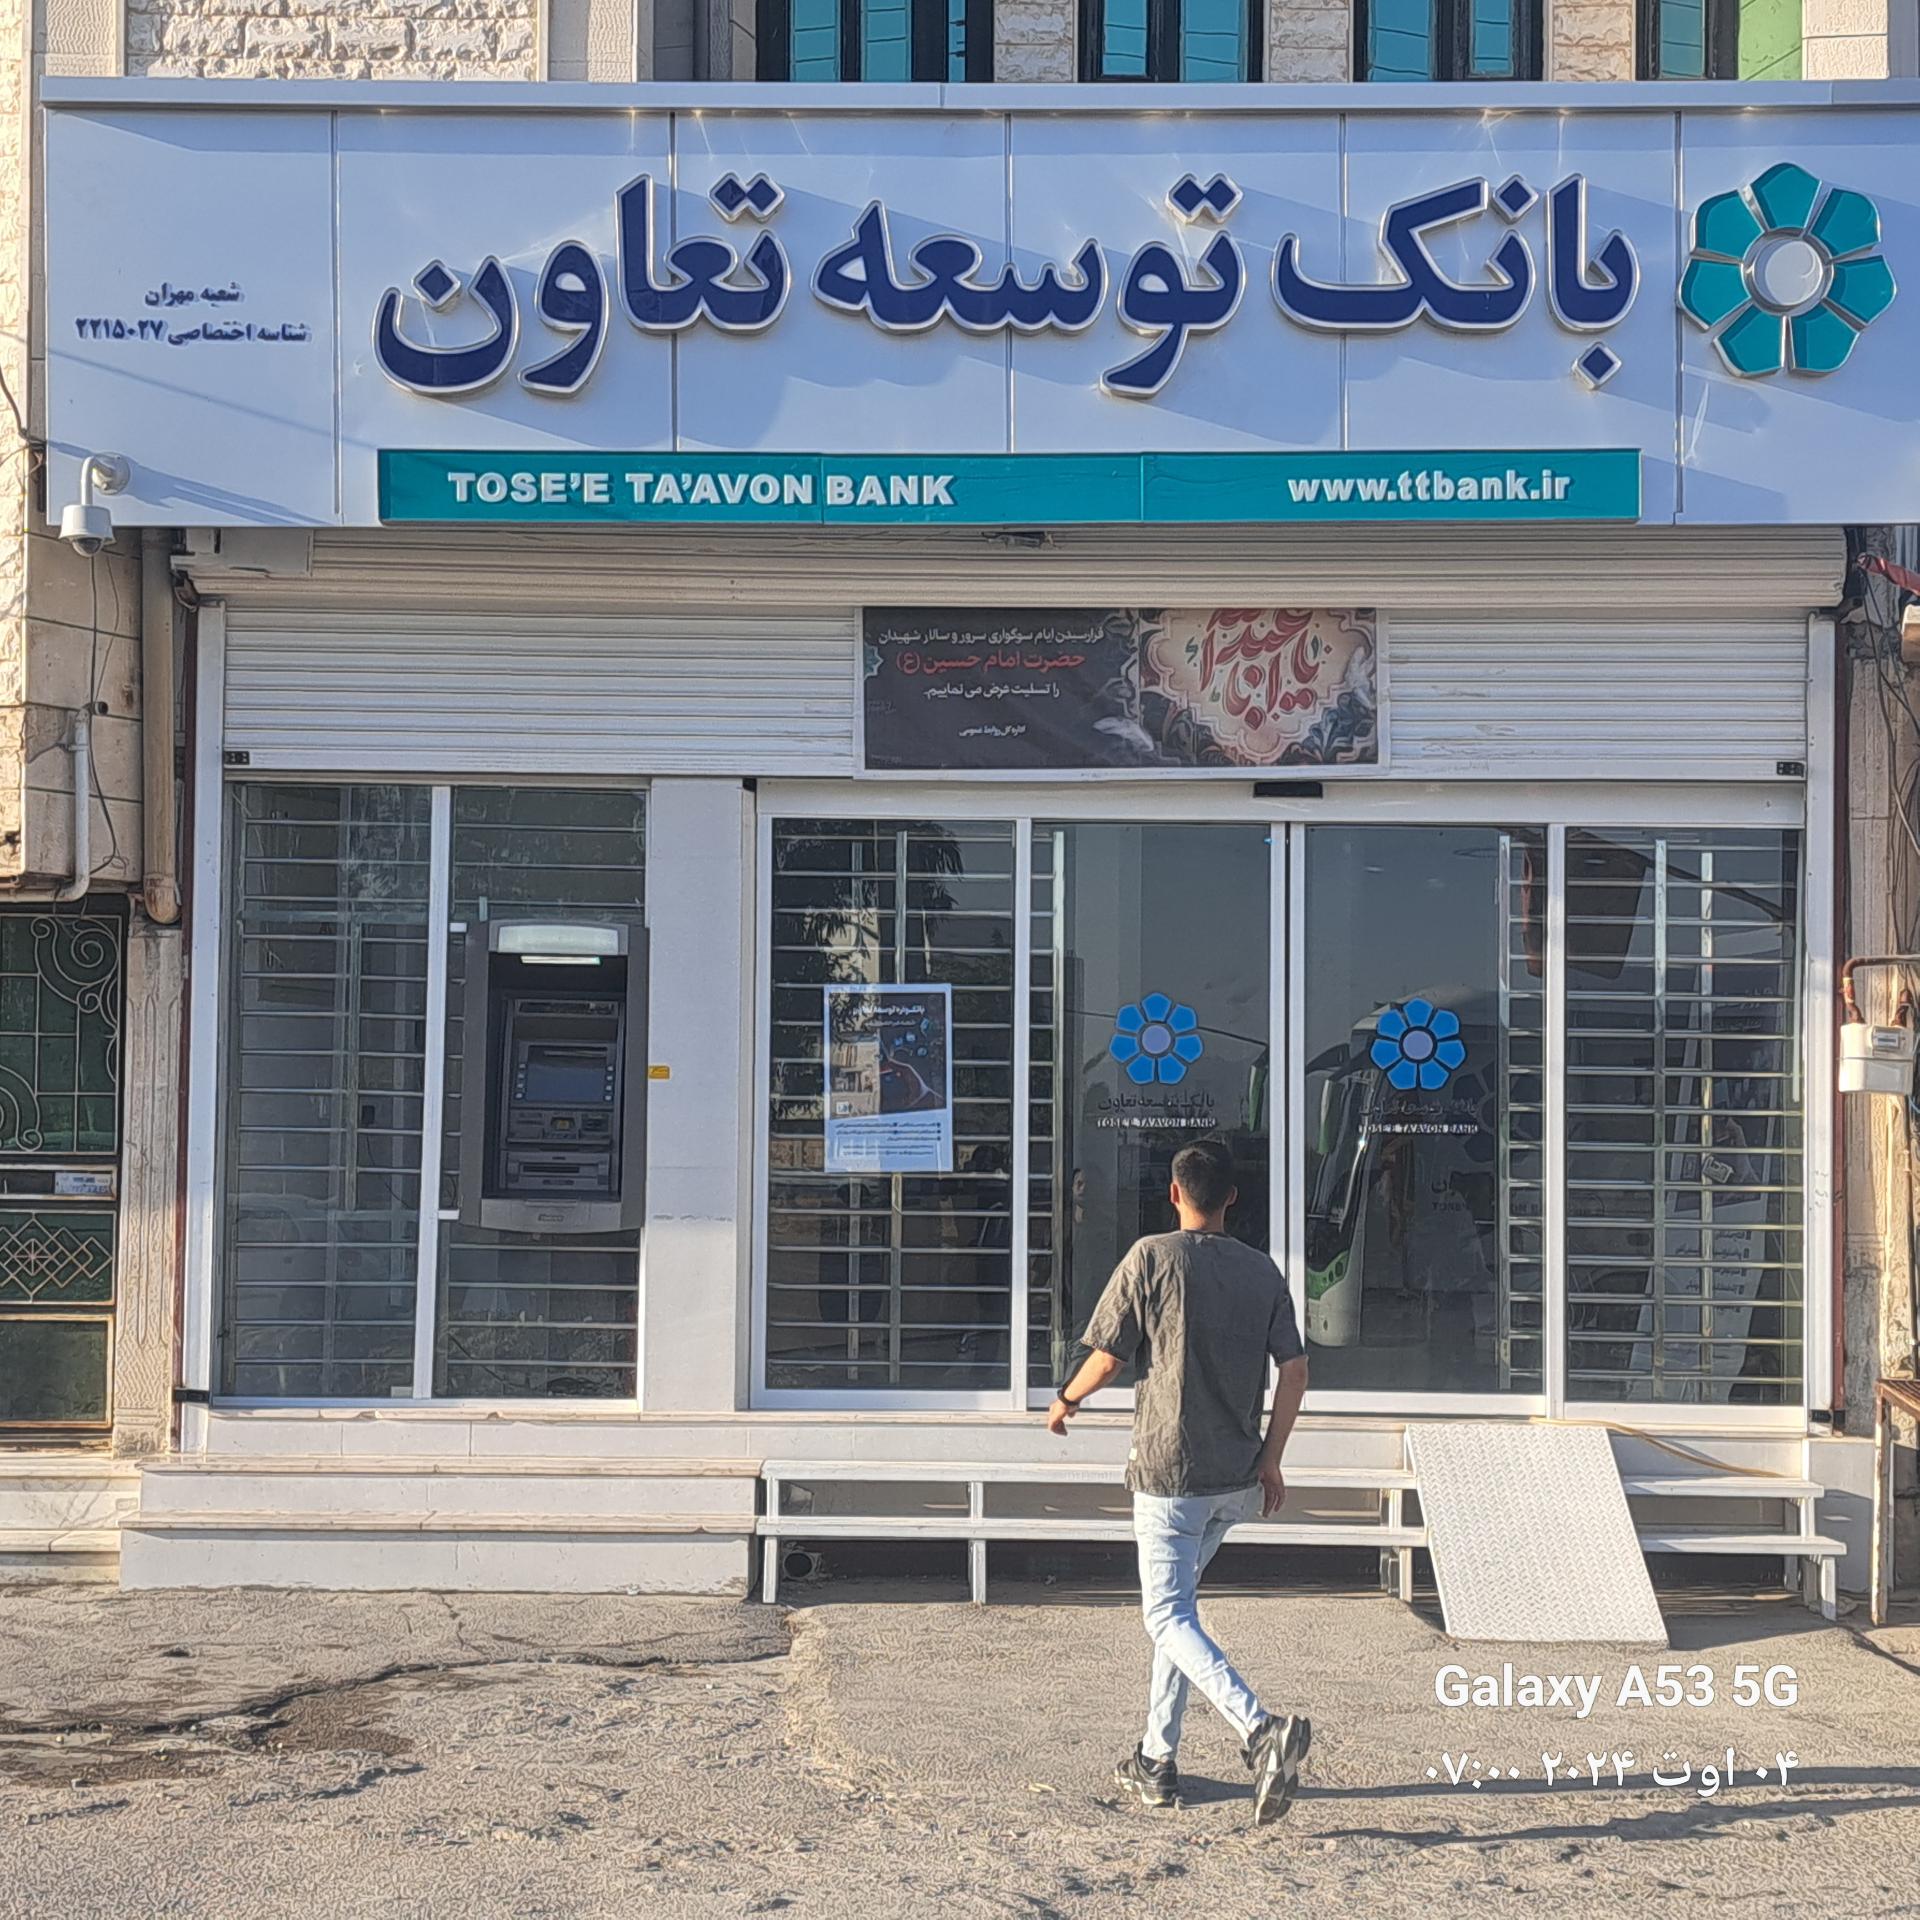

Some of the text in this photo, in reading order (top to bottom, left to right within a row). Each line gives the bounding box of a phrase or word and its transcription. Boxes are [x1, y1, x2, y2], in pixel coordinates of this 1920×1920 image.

[145, 281, 241, 307] شعبه مهران
[371, 172, 1640, 397] بانک توسعه تعاون
[168, 321, 251, 345] اختصاصی
[256, 322, 308, 342] شناسه
[826, 474, 957, 506] BANK
[1287, 468, 1573, 503] www.ttbank.ir
[878, 628, 921, 644] شهیدان
[923, 628, 951, 644] سالار
[988, 627, 1034, 644] سوگواری
[1034, 627, 1055, 646] ایام
[1055, 626, 1105, 644] فرارسیدن
[923, 655, 981, 674] حسین
[982, 649, 1020, 672] امام
[1023, 651, 1086, 673] حضرت
[983, 683, 1010, 699] عرض
[1010, 682, 1051, 698] تسلیت
